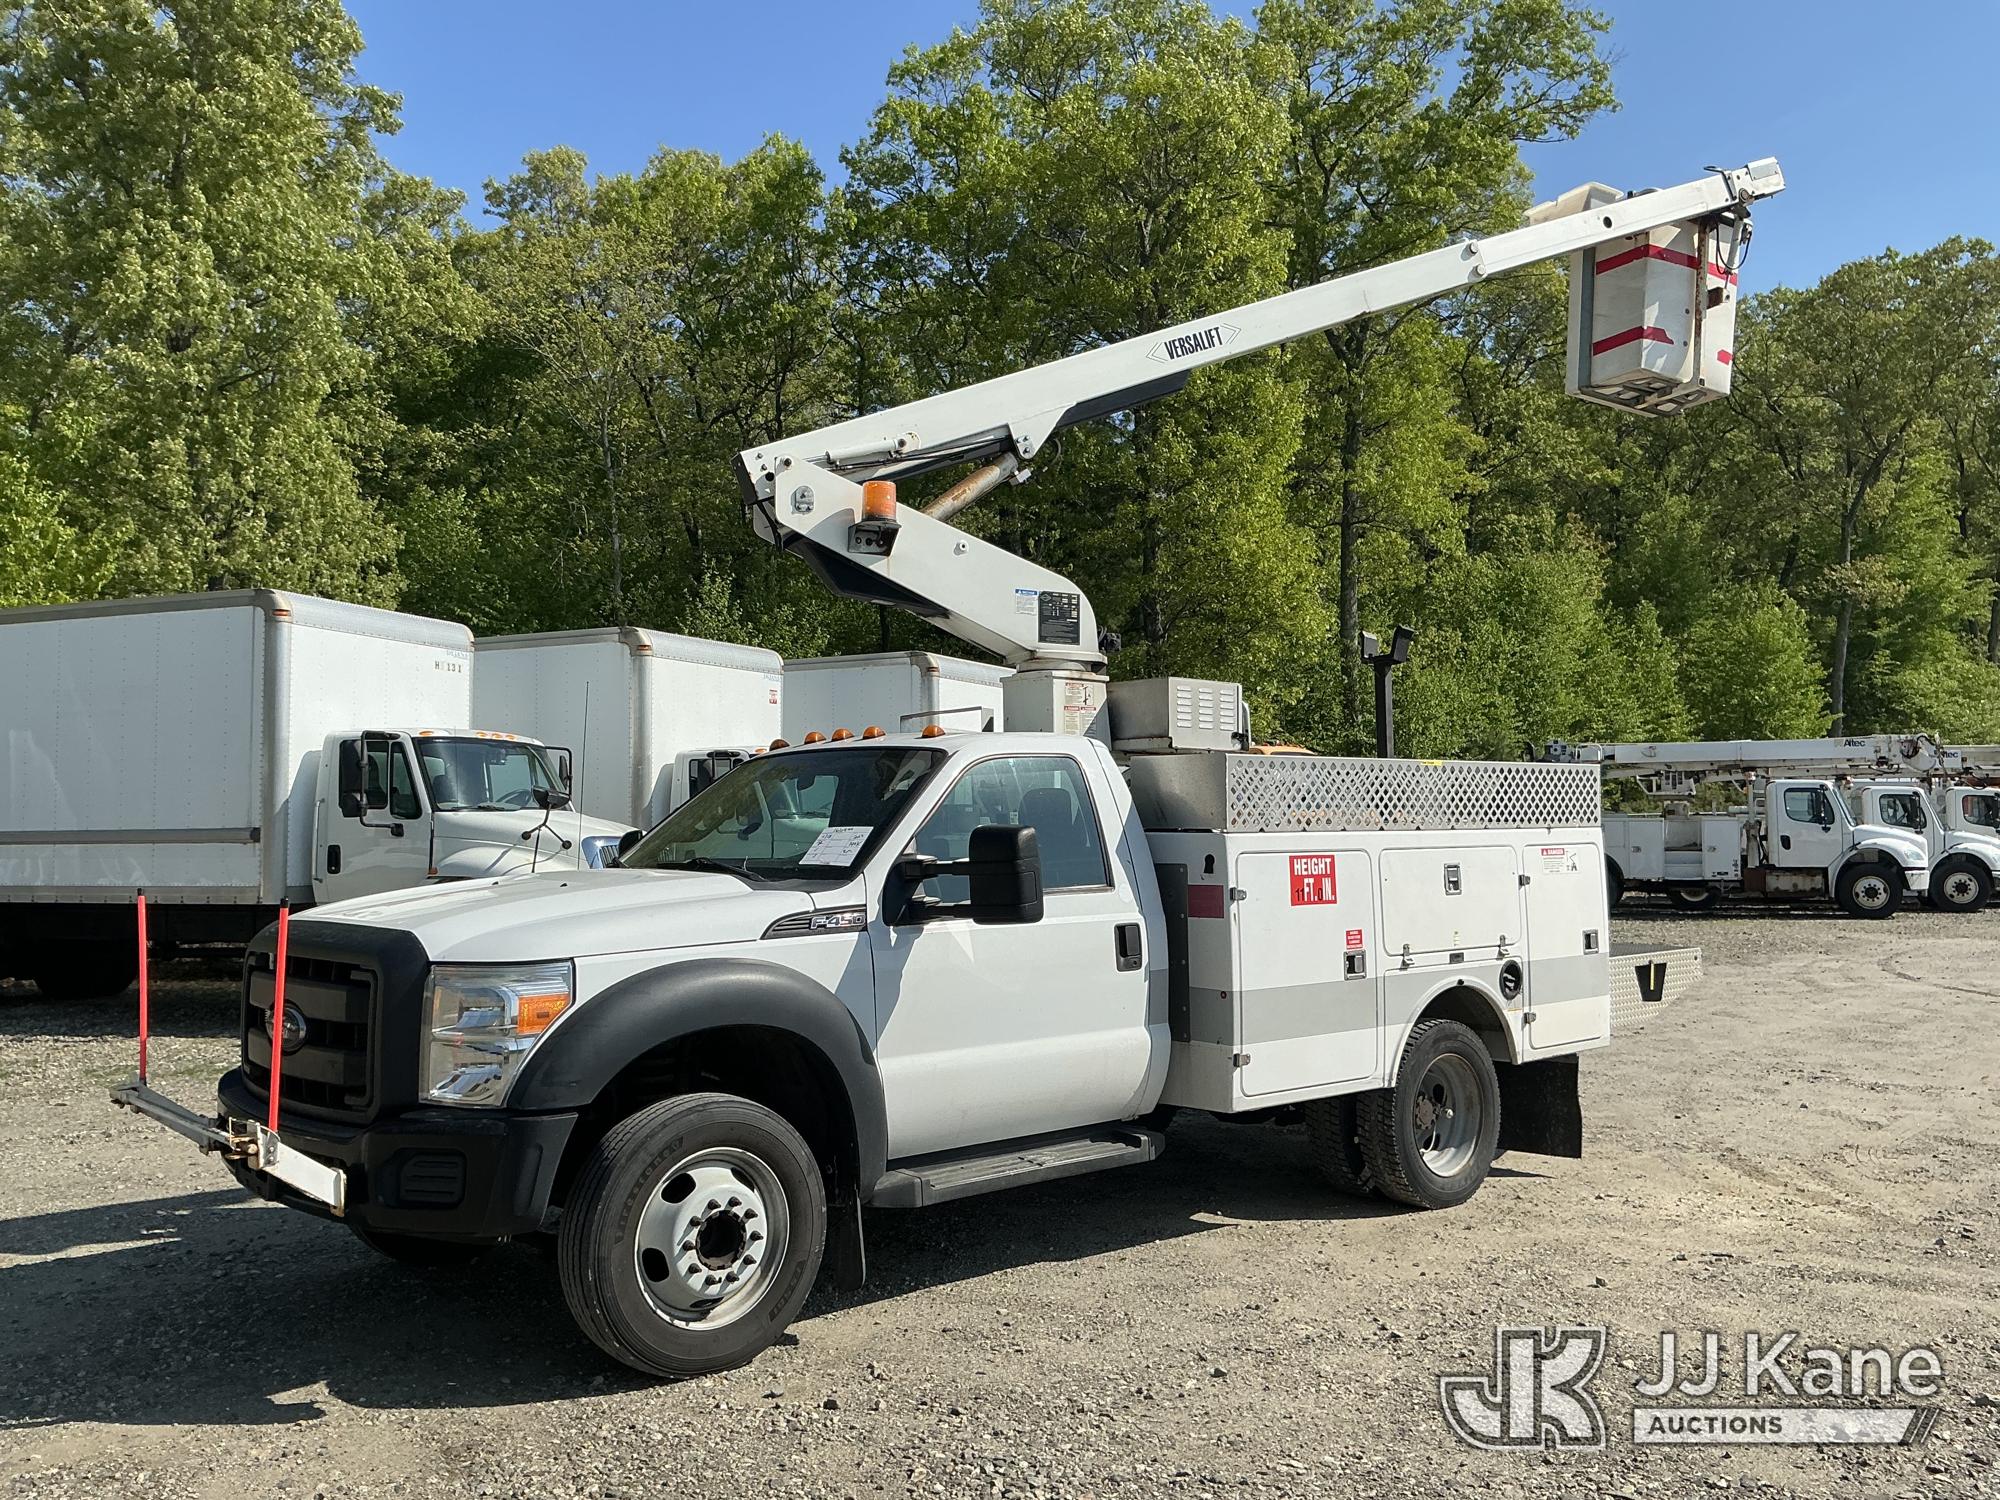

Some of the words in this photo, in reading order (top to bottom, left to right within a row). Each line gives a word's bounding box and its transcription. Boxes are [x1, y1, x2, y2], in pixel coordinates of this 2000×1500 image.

[1164, 326, 1223, 360] VERSALIFT
[1844, 738, 1866, 747] Altec
[1294, 857, 1332, 876] HEIGHT
[810, 913, 866, 929] F-450
